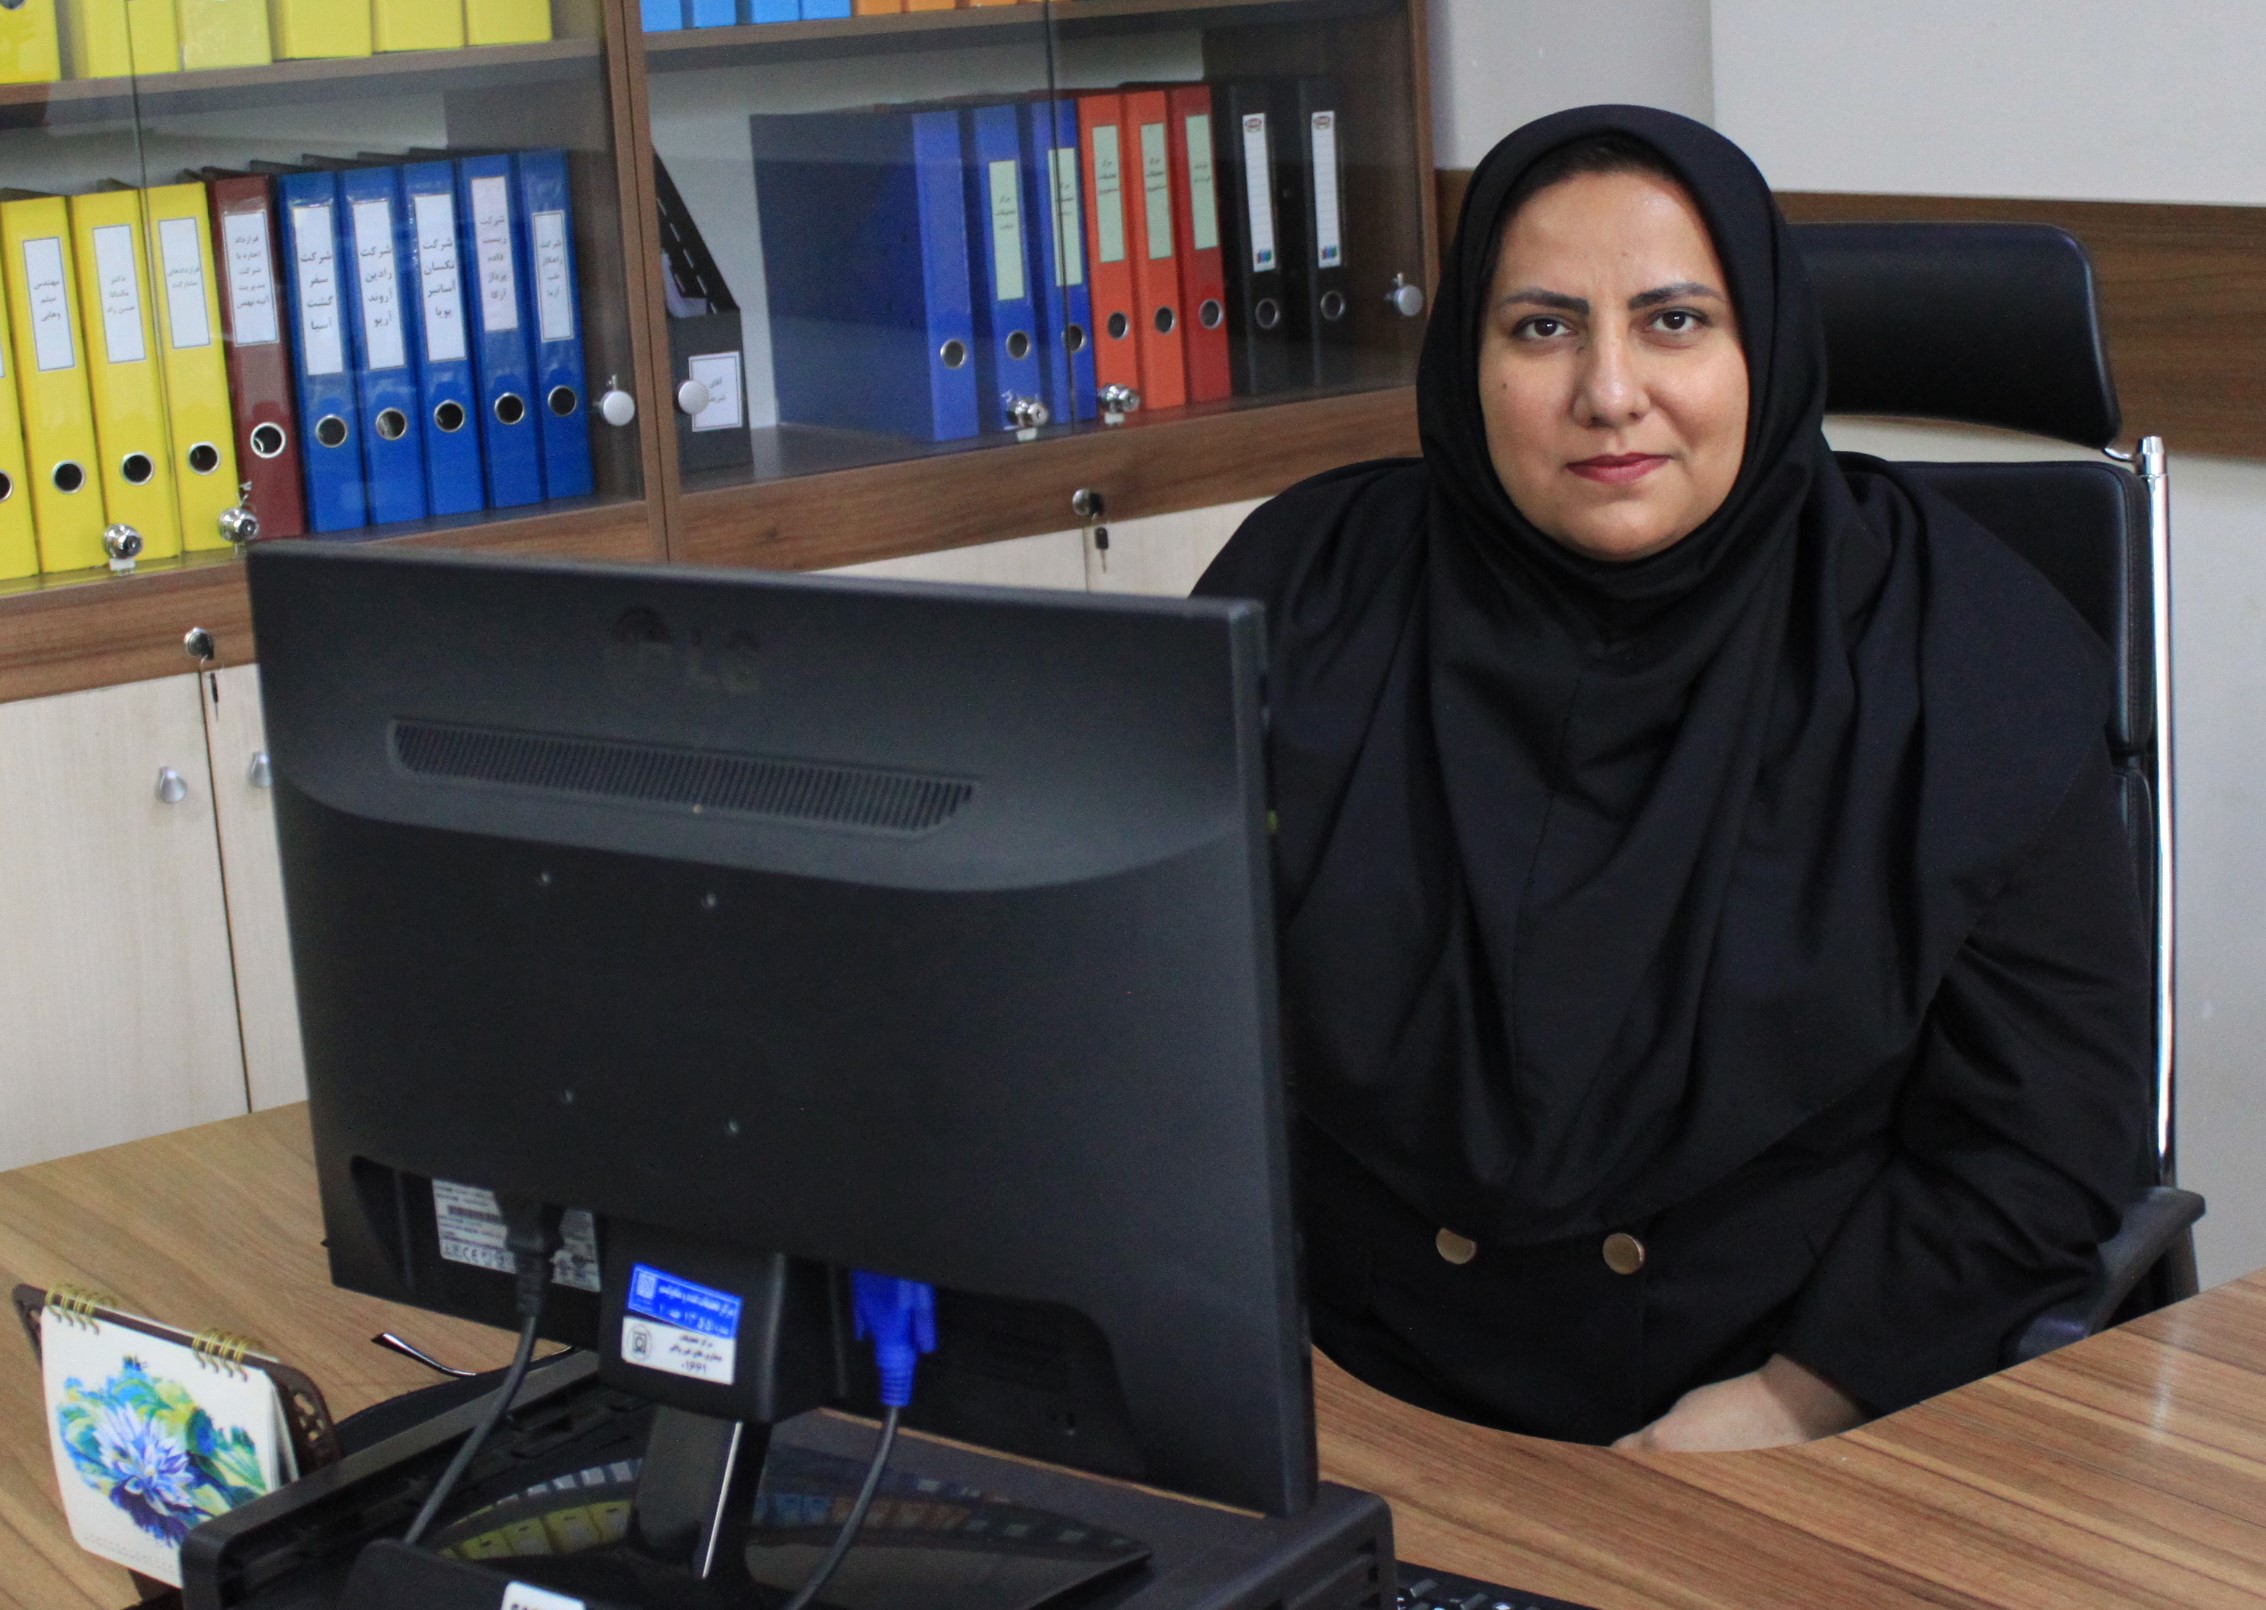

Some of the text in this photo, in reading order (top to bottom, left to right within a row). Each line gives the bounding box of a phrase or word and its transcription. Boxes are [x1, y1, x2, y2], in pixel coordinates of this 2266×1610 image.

[423, 236, 453, 251] شرکت
[301, 250, 333, 265] شرکت
[360, 245, 392, 259] شرکت
